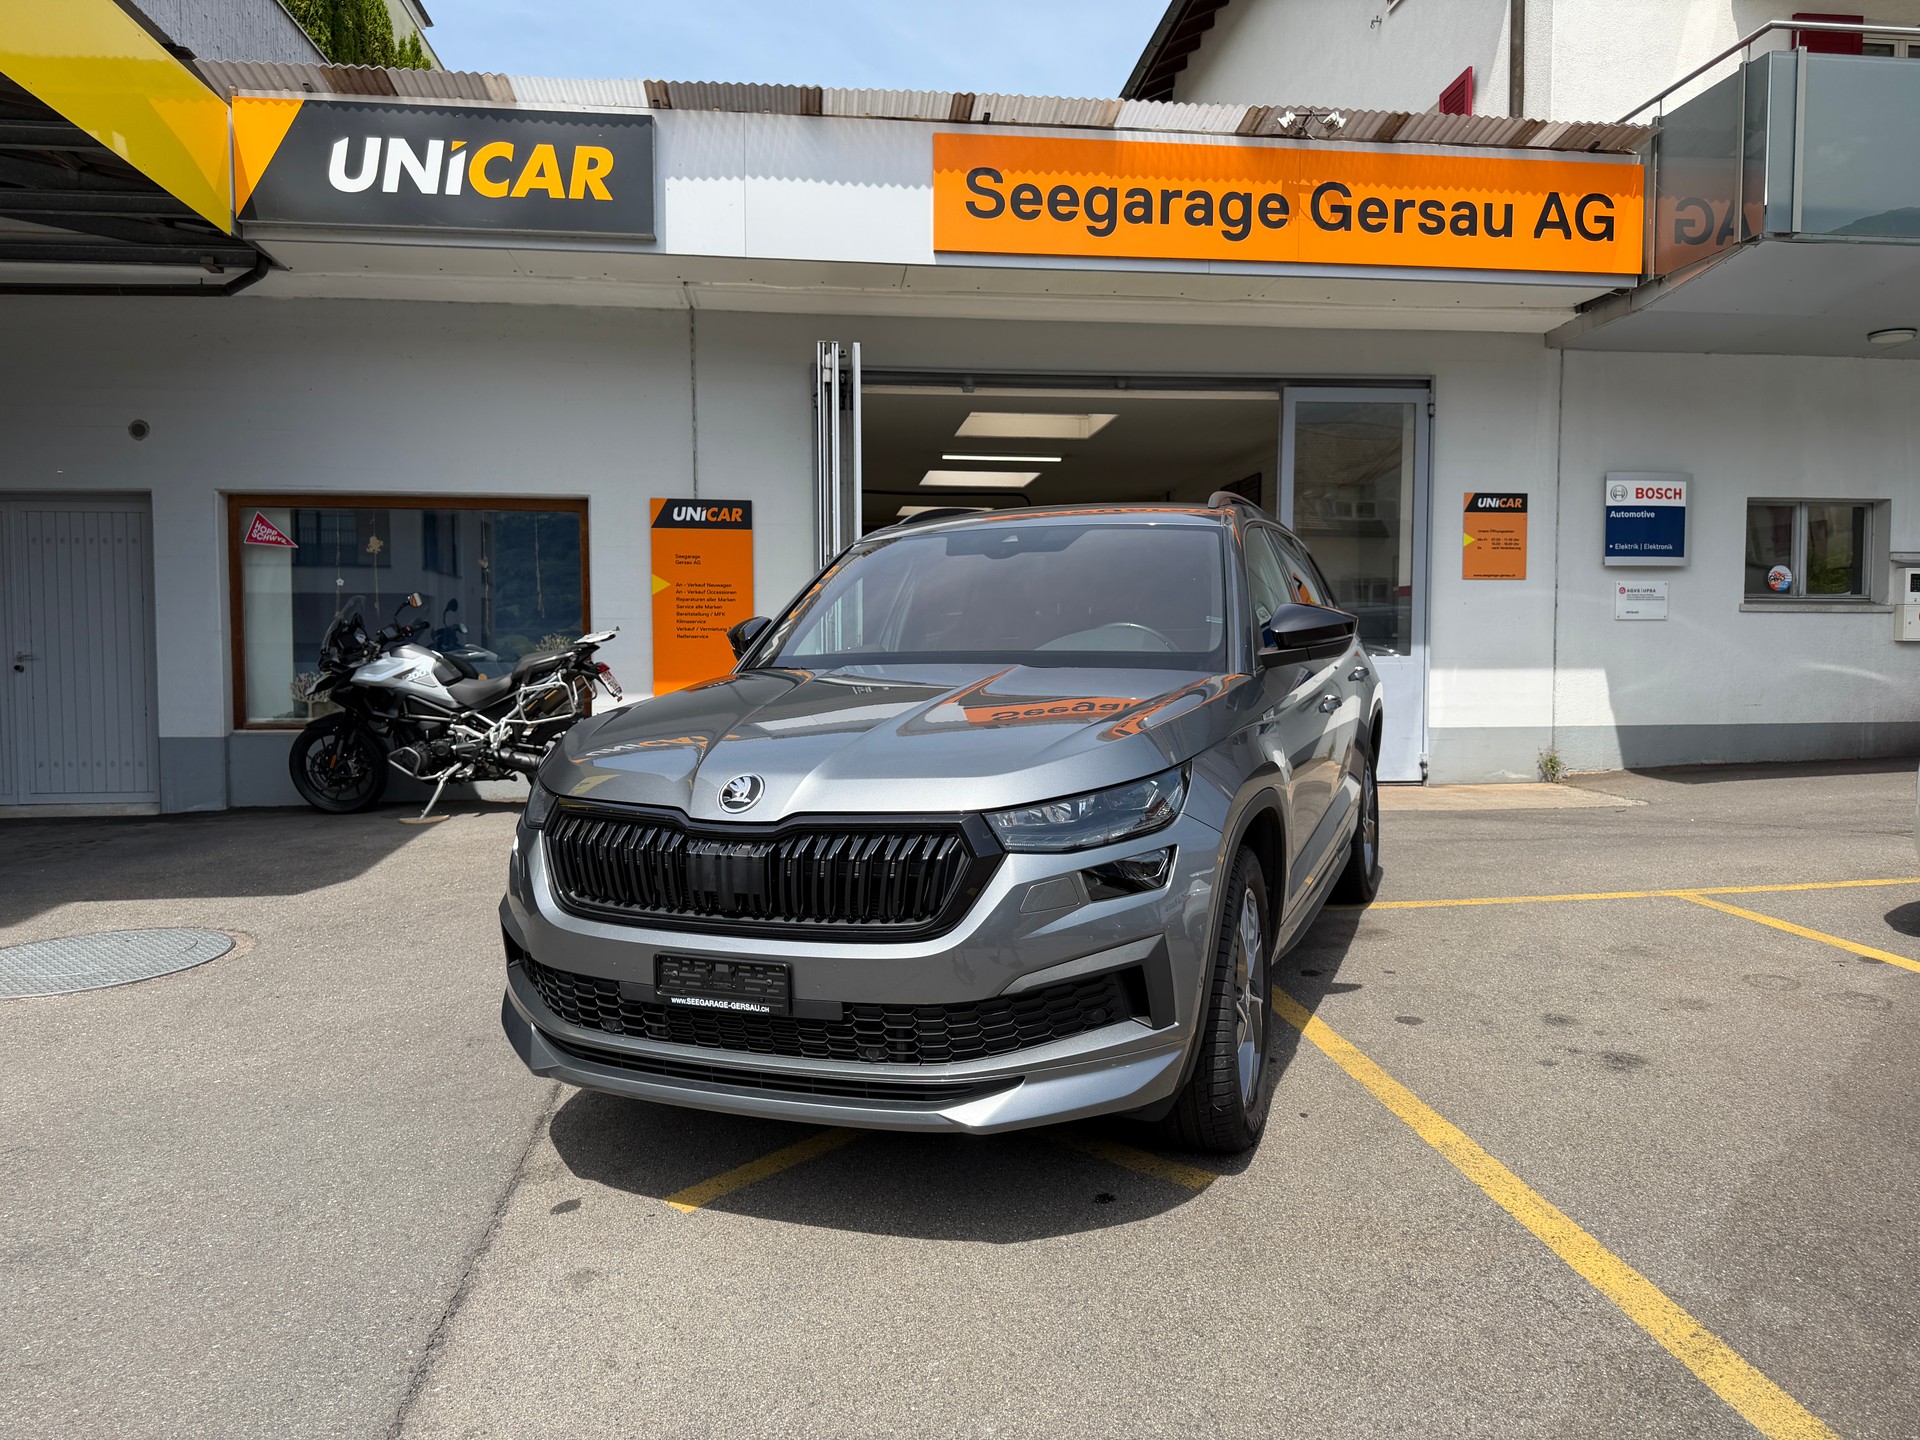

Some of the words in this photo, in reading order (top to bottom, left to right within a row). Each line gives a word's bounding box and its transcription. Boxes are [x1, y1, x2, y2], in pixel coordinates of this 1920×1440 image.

[965, 167, 1290, 242] Seegarage
[1310, 181, 1513, 239] Gersau
[1533, 191, 1615, 242] AG
[1635, 487, 1682, 500] BOSCH
[1609, 510, 1655, 519] Automotive
[254, 520, 278, 535] HOPP
